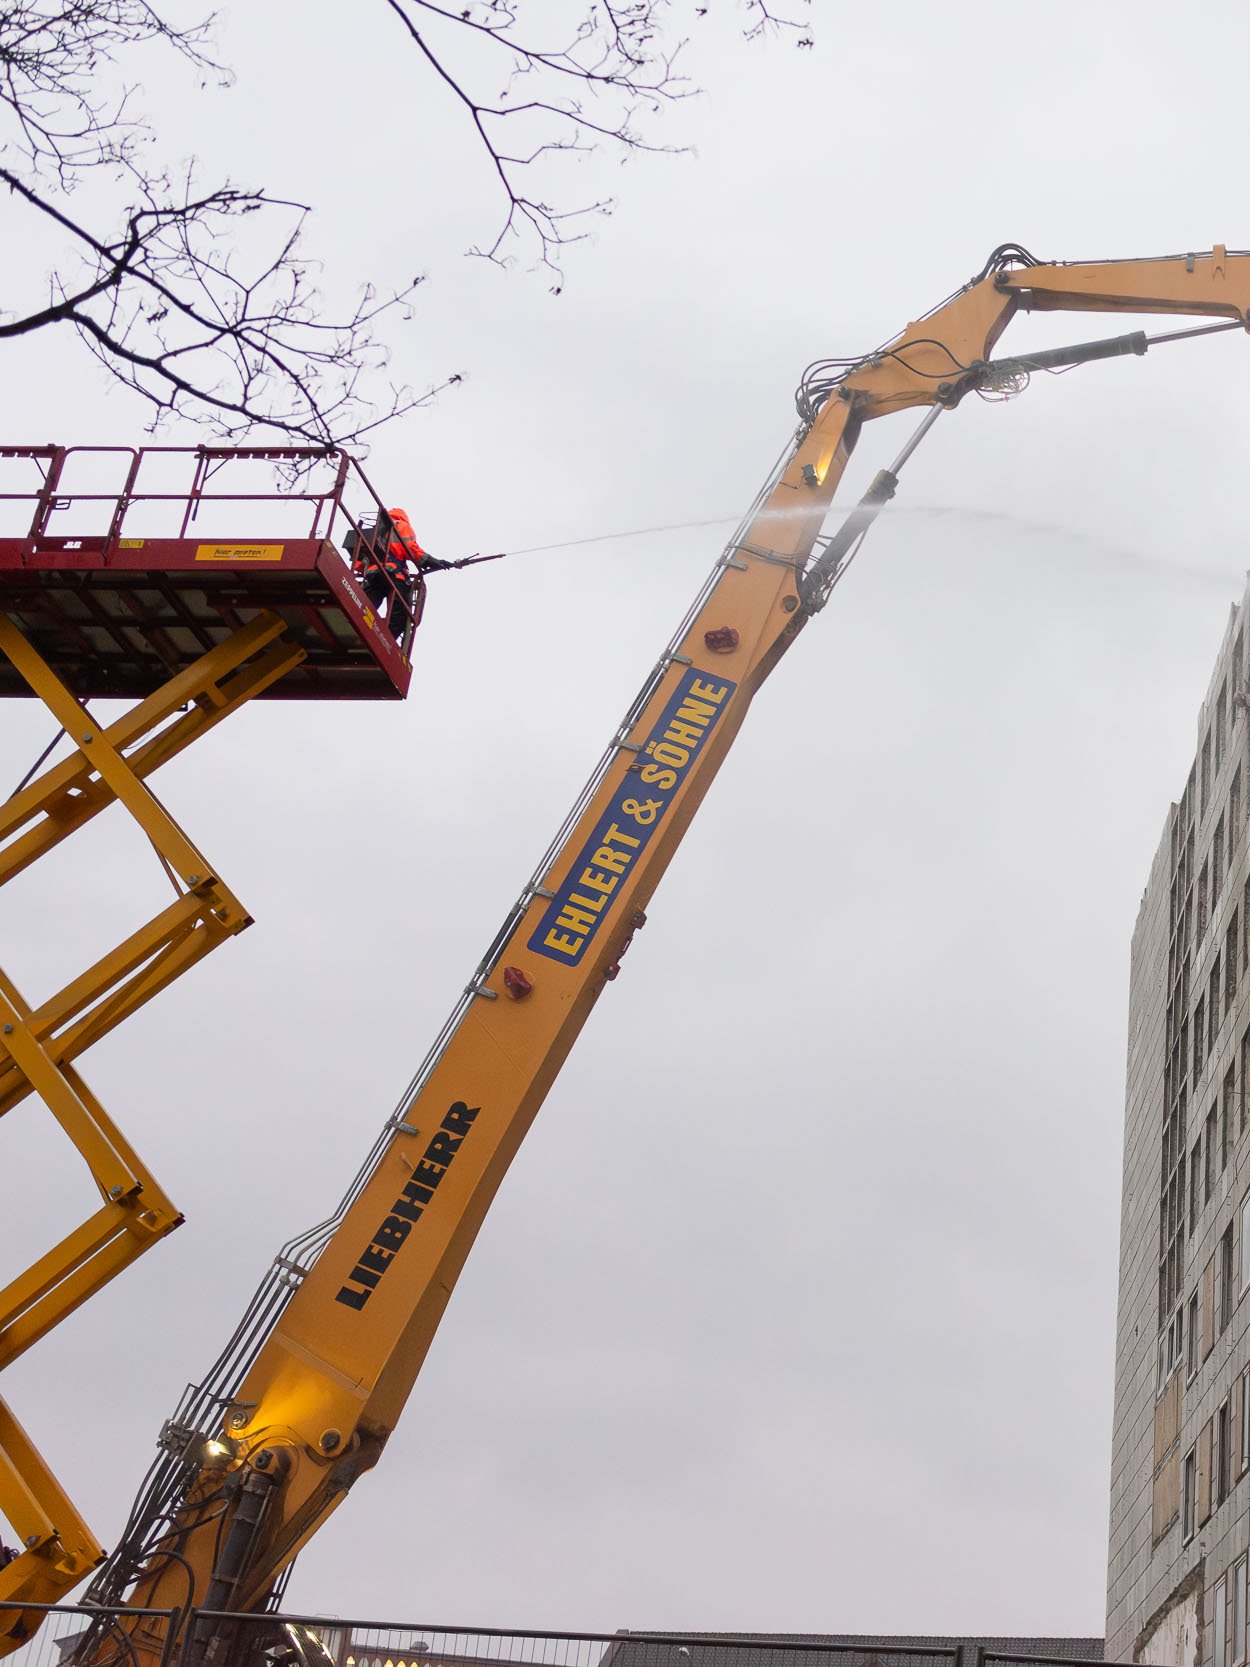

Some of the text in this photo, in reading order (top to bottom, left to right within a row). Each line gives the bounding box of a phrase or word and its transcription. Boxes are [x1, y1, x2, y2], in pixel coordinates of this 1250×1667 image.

[543, 678, 728, 957] EHLERT & SÖHNE
[334, 1101, 482, 1312] LIEBHERR
